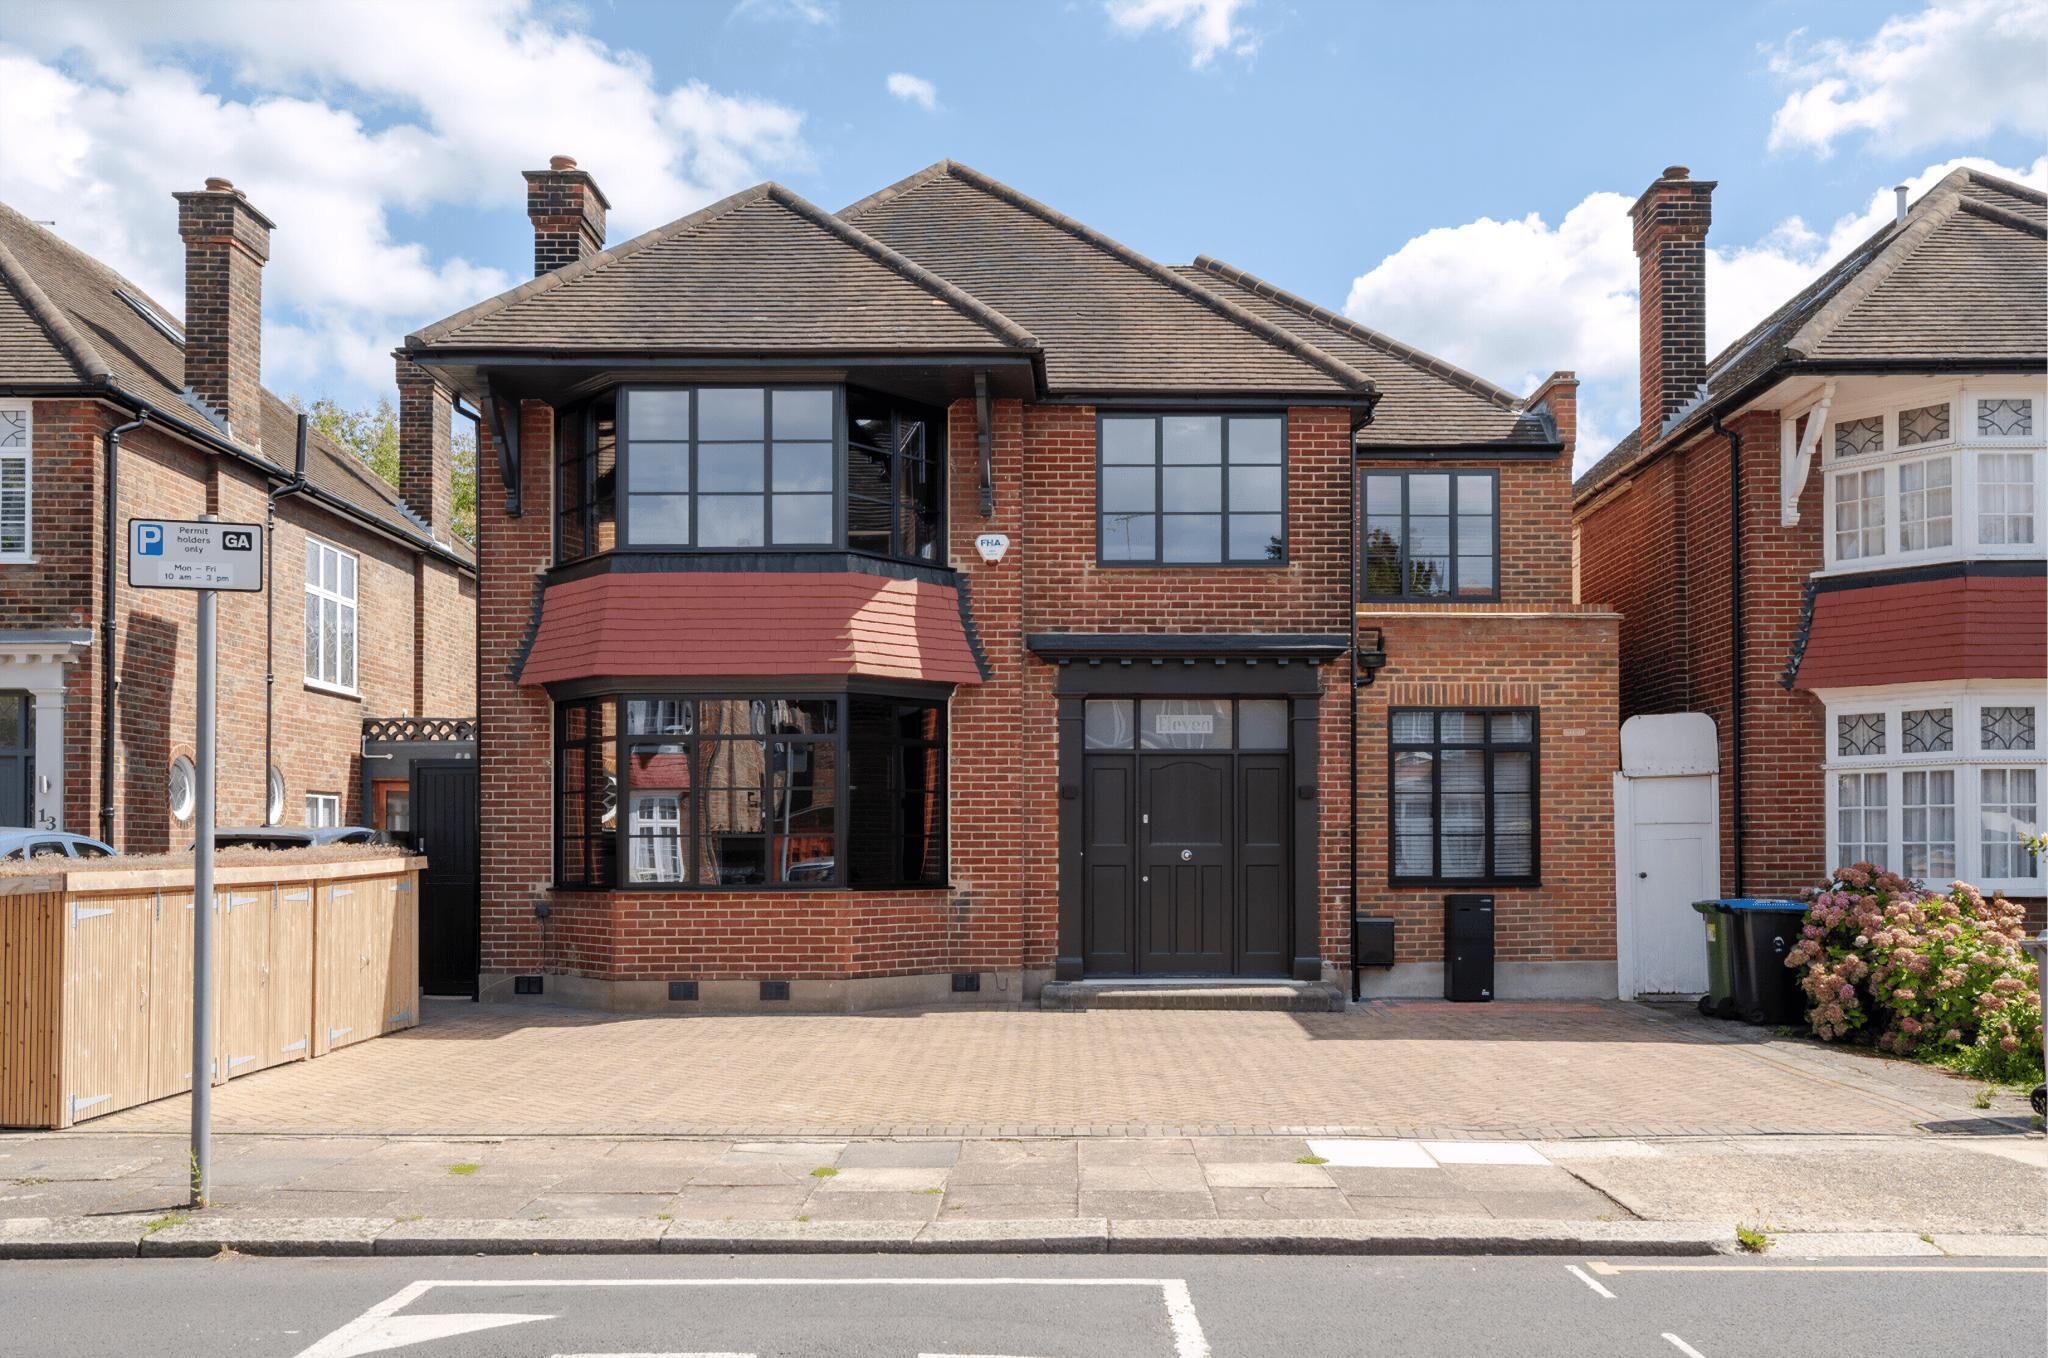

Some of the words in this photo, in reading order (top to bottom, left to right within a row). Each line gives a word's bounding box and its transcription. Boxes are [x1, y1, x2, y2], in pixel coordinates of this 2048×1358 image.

[179, 526, 209, 535] Permit
[140, 525, 162, 554] P
[177, 536, 211, 544] holders
[224, 534, 250, 549] GA
[981, 539, 1001, 547] FHA
[184, 545, 204, 554] only
[174, 564, 192, 572] Mon
[38, 808, 57, 831] 13
